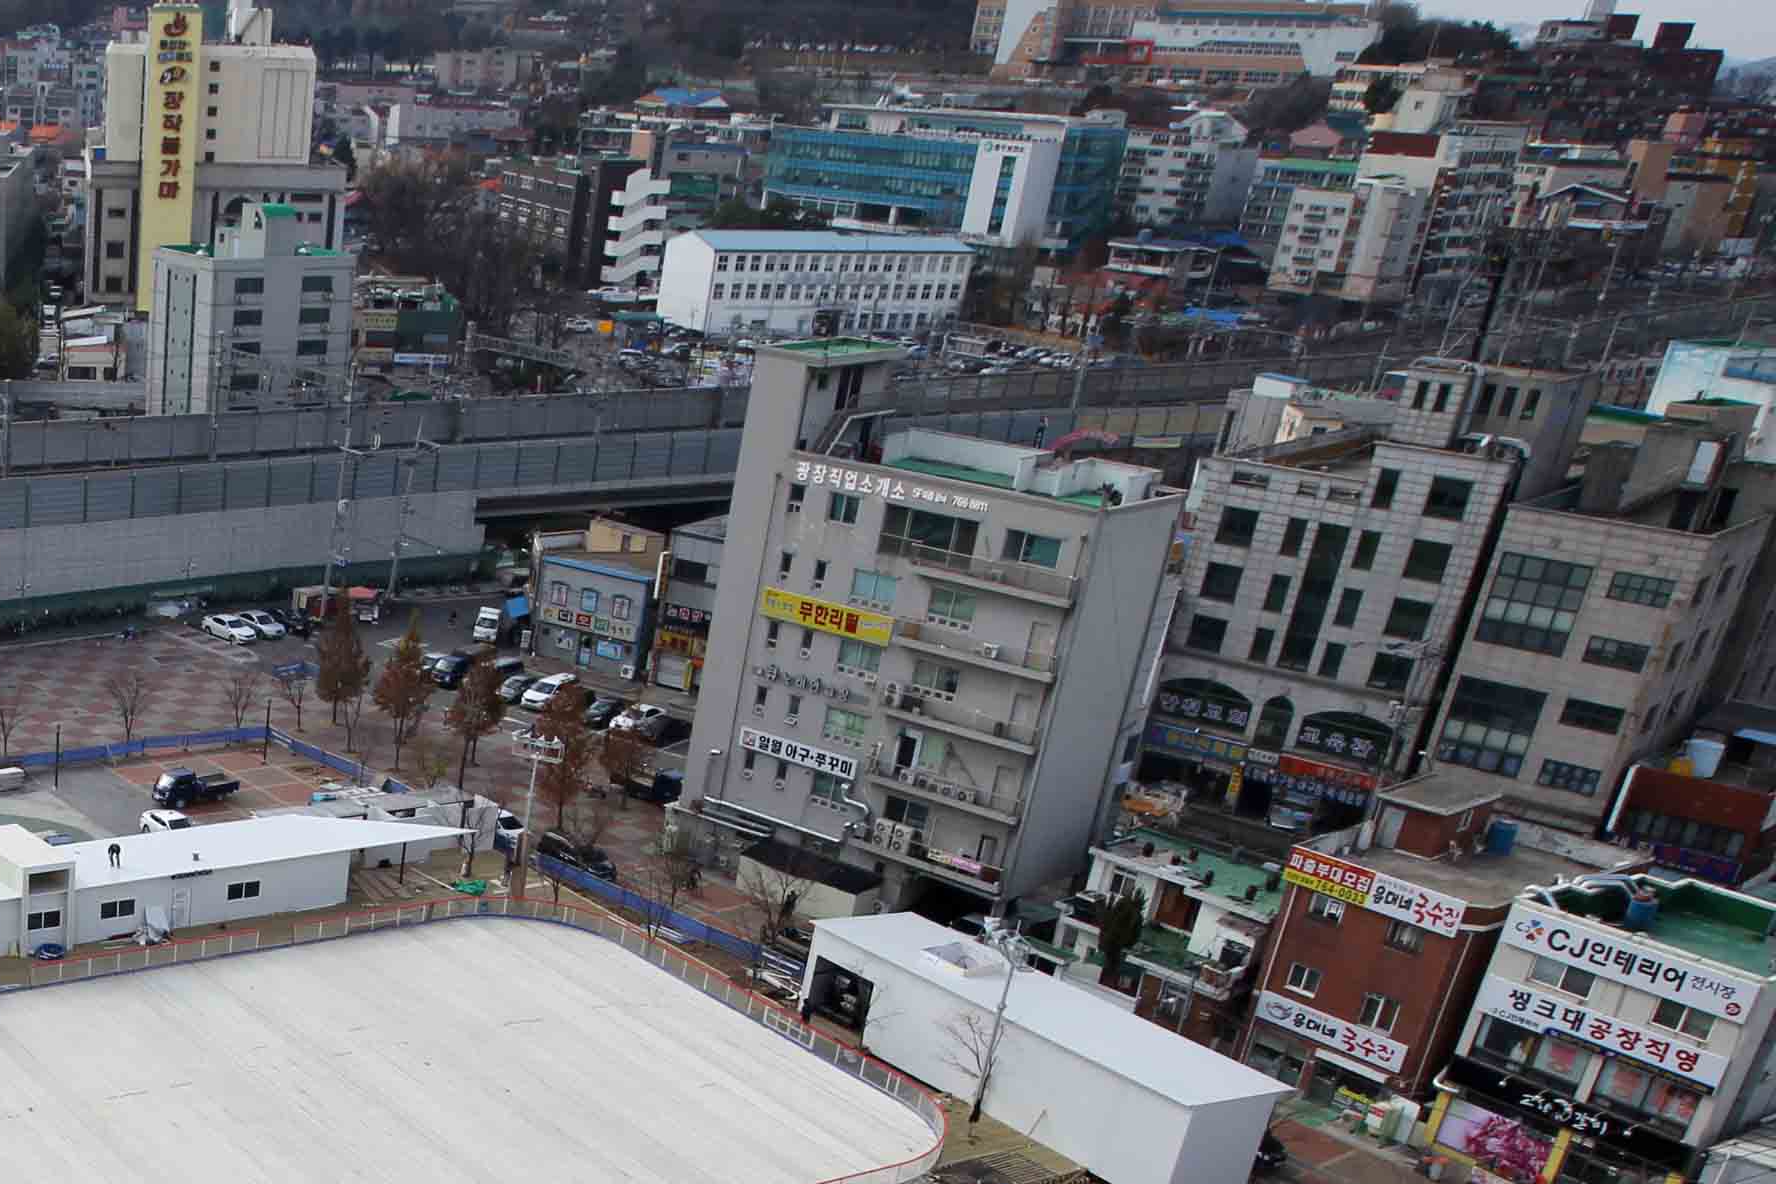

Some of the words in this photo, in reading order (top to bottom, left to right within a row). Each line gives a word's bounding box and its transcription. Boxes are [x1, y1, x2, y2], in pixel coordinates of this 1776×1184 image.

[796, 461, 906, 500] 광장직업소개소
[800, 600, 859, 634] 무한리필
[1413, 893, 1461, 929] 국수집
[1548, 928, 1688, 993] CJ인테리어
[1690, 974, 1737, 1000] 전시장
[1342, 1027, 1395, 1062] 국수집
